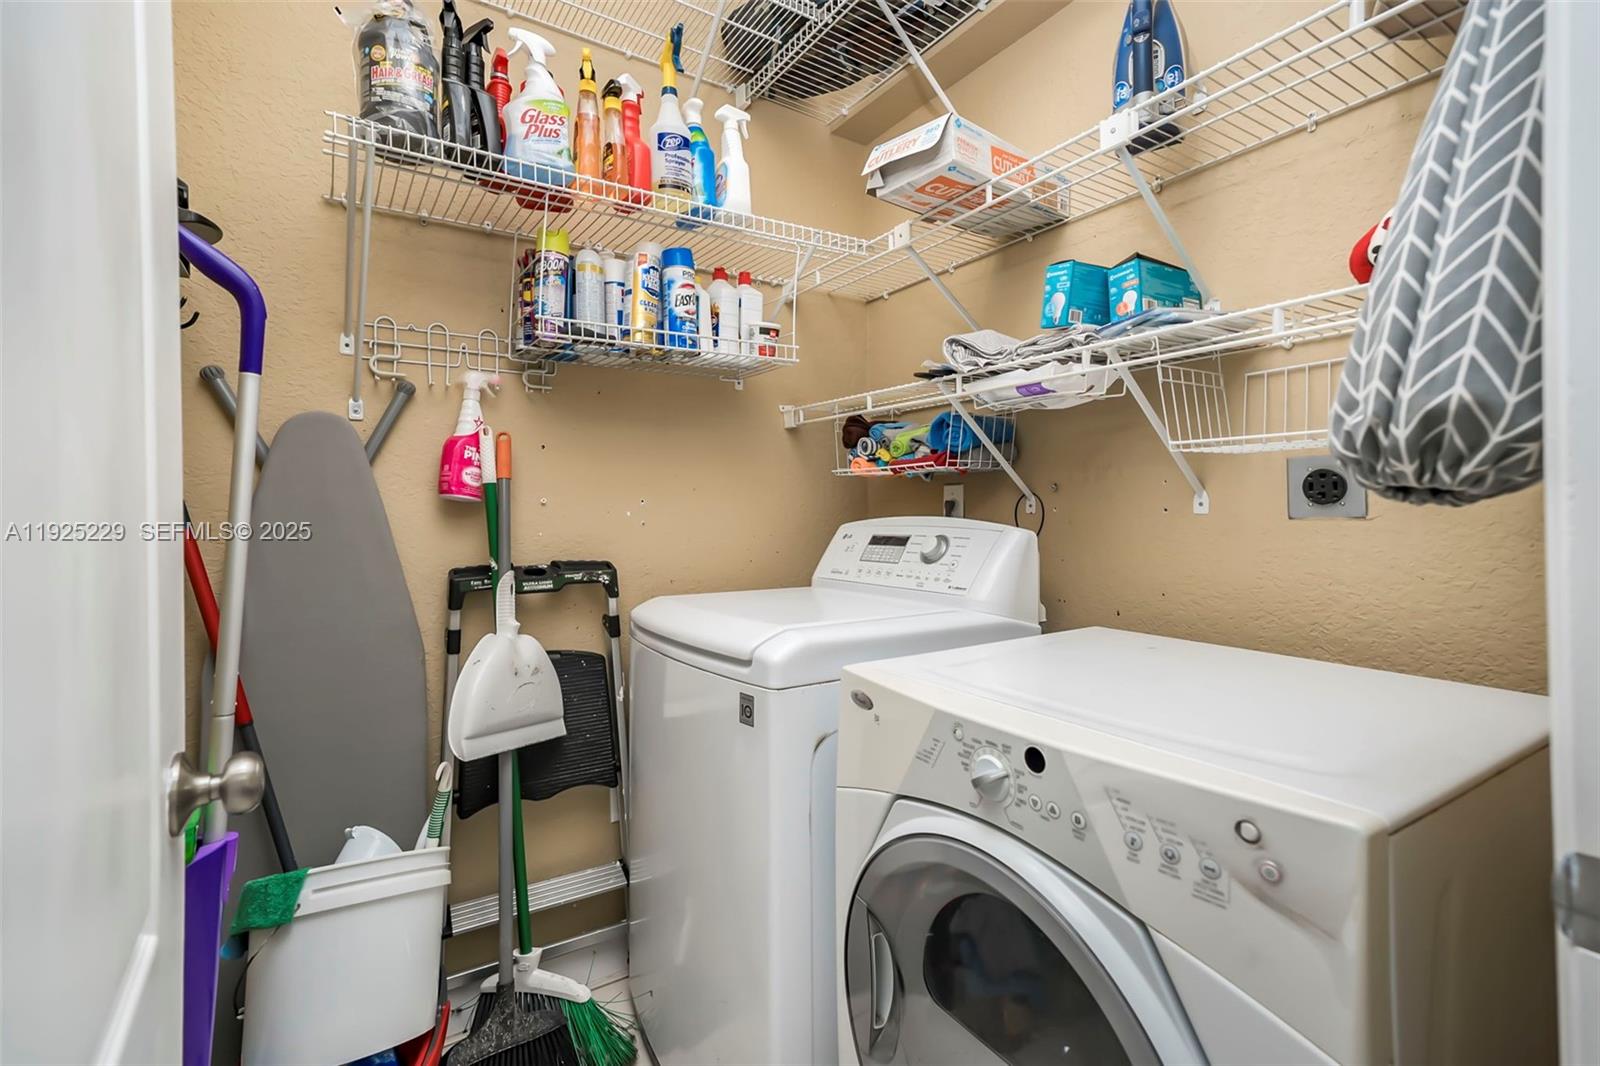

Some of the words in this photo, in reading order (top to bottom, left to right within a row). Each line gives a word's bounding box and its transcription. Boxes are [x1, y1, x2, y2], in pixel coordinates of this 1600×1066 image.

[371, 65, 394, 79] HAIR
[520, 108, 566, 126] Glass
[523, 124, 561, 140] Plus
[867, 137, 918, 168] CUTLERY
[464, 450, 480, 462] PIN
